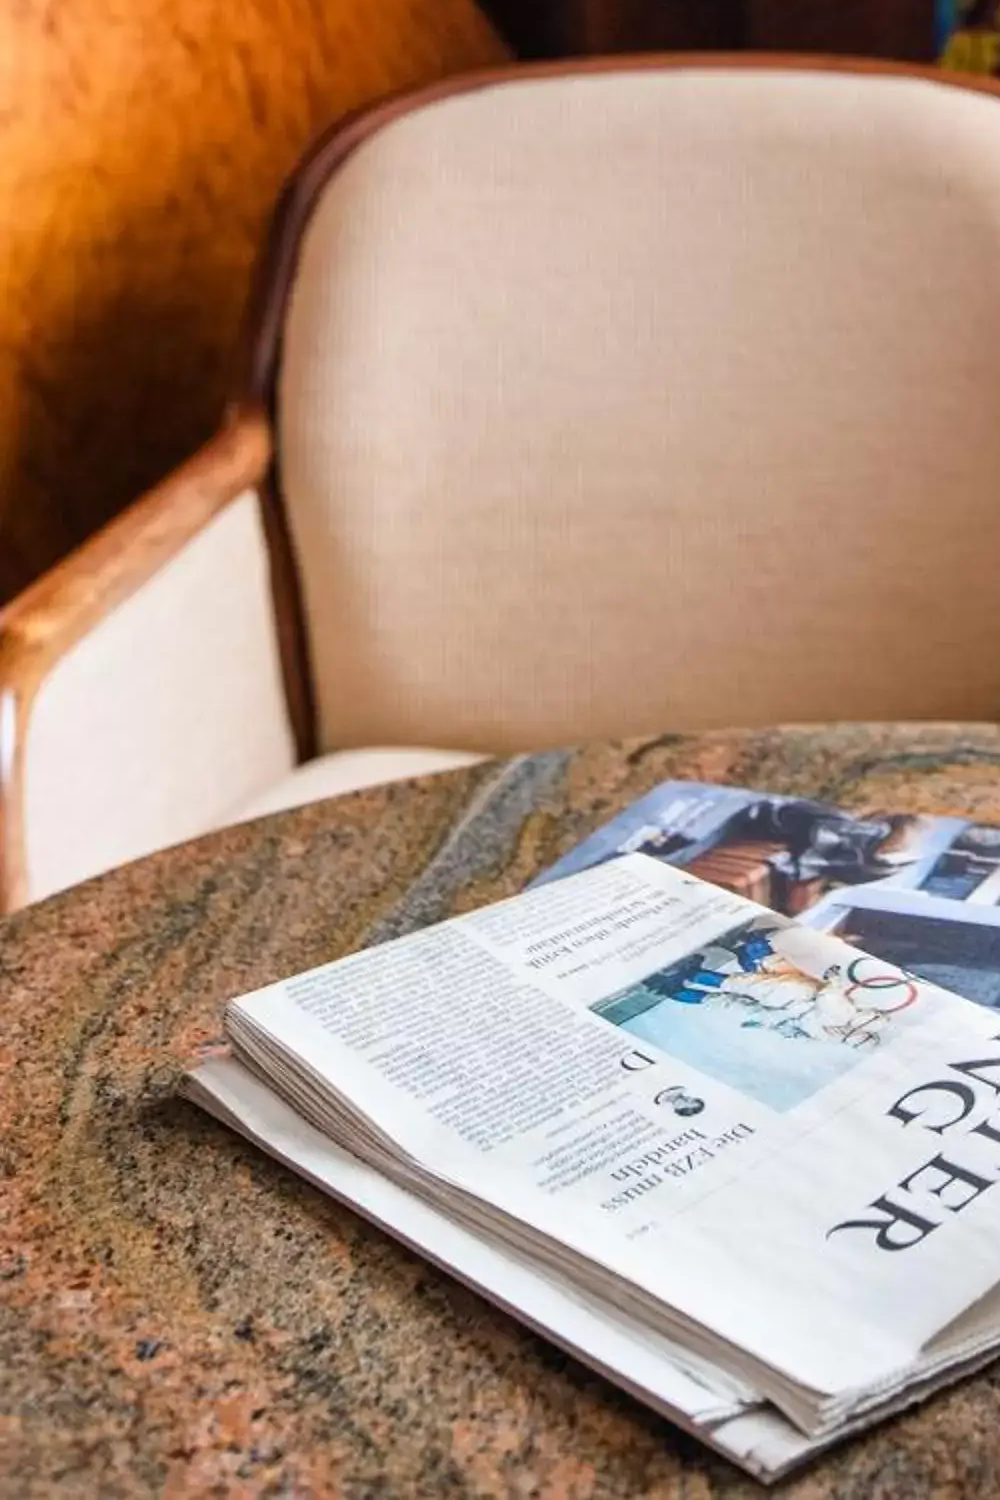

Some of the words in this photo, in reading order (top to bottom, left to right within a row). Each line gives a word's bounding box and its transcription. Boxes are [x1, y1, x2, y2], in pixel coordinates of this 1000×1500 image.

[716, 1123, 756, 1148] Die
[610, 1128, 707, 1181] handeln
[663, 1147, 715, 1178] EZB
[600, 1173, 663, 1211] muss
